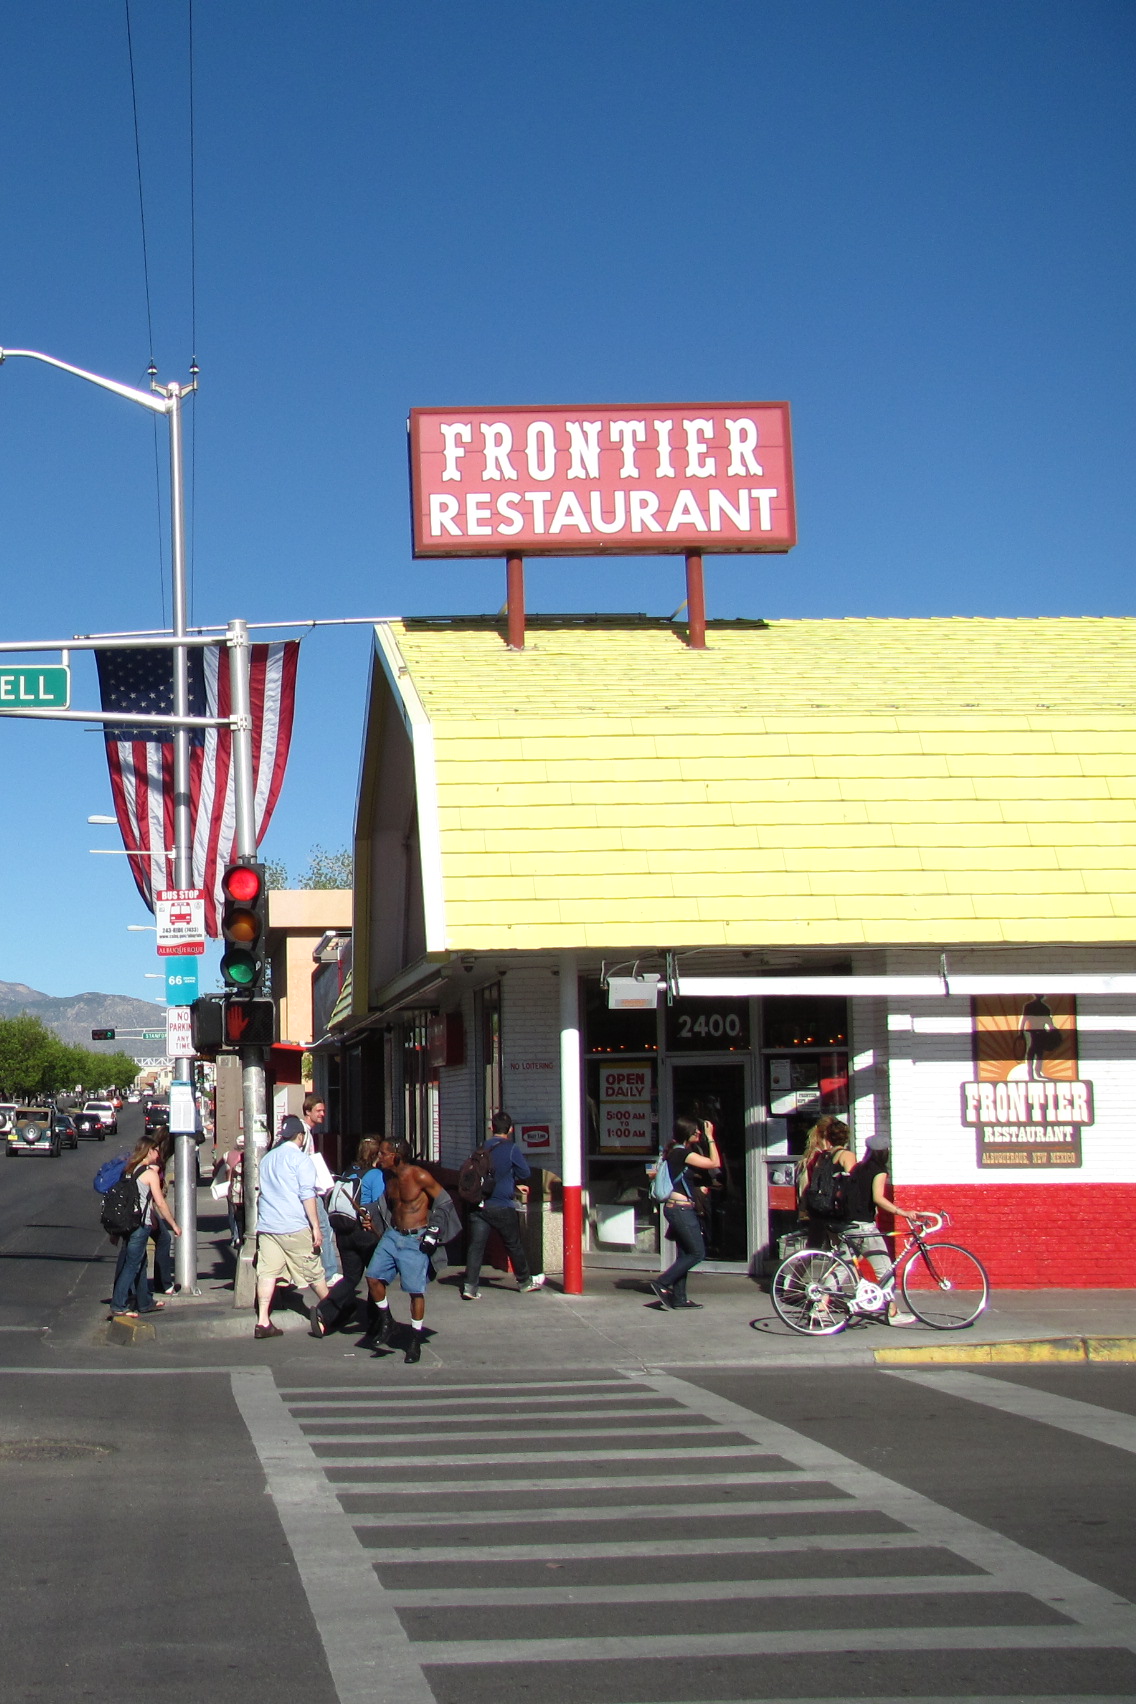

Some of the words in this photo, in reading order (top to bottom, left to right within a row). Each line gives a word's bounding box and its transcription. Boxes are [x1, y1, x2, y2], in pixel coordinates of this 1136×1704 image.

[440, 418, 763, 482] FRONTIER
[429, 488, 778, 536] RESTAURANT
[161, 890, 178, 901] BUS
[179, 889, 200, 900] STOP
[158, 945, 204, 955] ALBUQUERQUE
[168, 975, 183, 986] 66
[177, 1011, 189, 1022] NO
[169, 1022, 193, 1032] PARKIN
[677, 1013, 741, 1038] 2400
[175, 1042, 191, 1050] TIME
[510, 1062, 520, 1070] NO
[522, 1061, 554, 1070] LOITERING
[605, 1073, 646, 1086] OPEN
[605, 1086, 645, 1097] DAILY
[965, 1081, 1089, 1123] FRONTIER
[606, 1110, 631, 1121] 5:00
[632, 1112, 646, 1120] AM
[607, 1127, 631, 1138] 1:00
[632, 1130, 646, 1138] AM
[983, 1125, 1074, 1142] RESTAURANT
[1032, 1151, 1047, 1164] NEW
[1050, 1151, 1076, 1163] MEXICO
